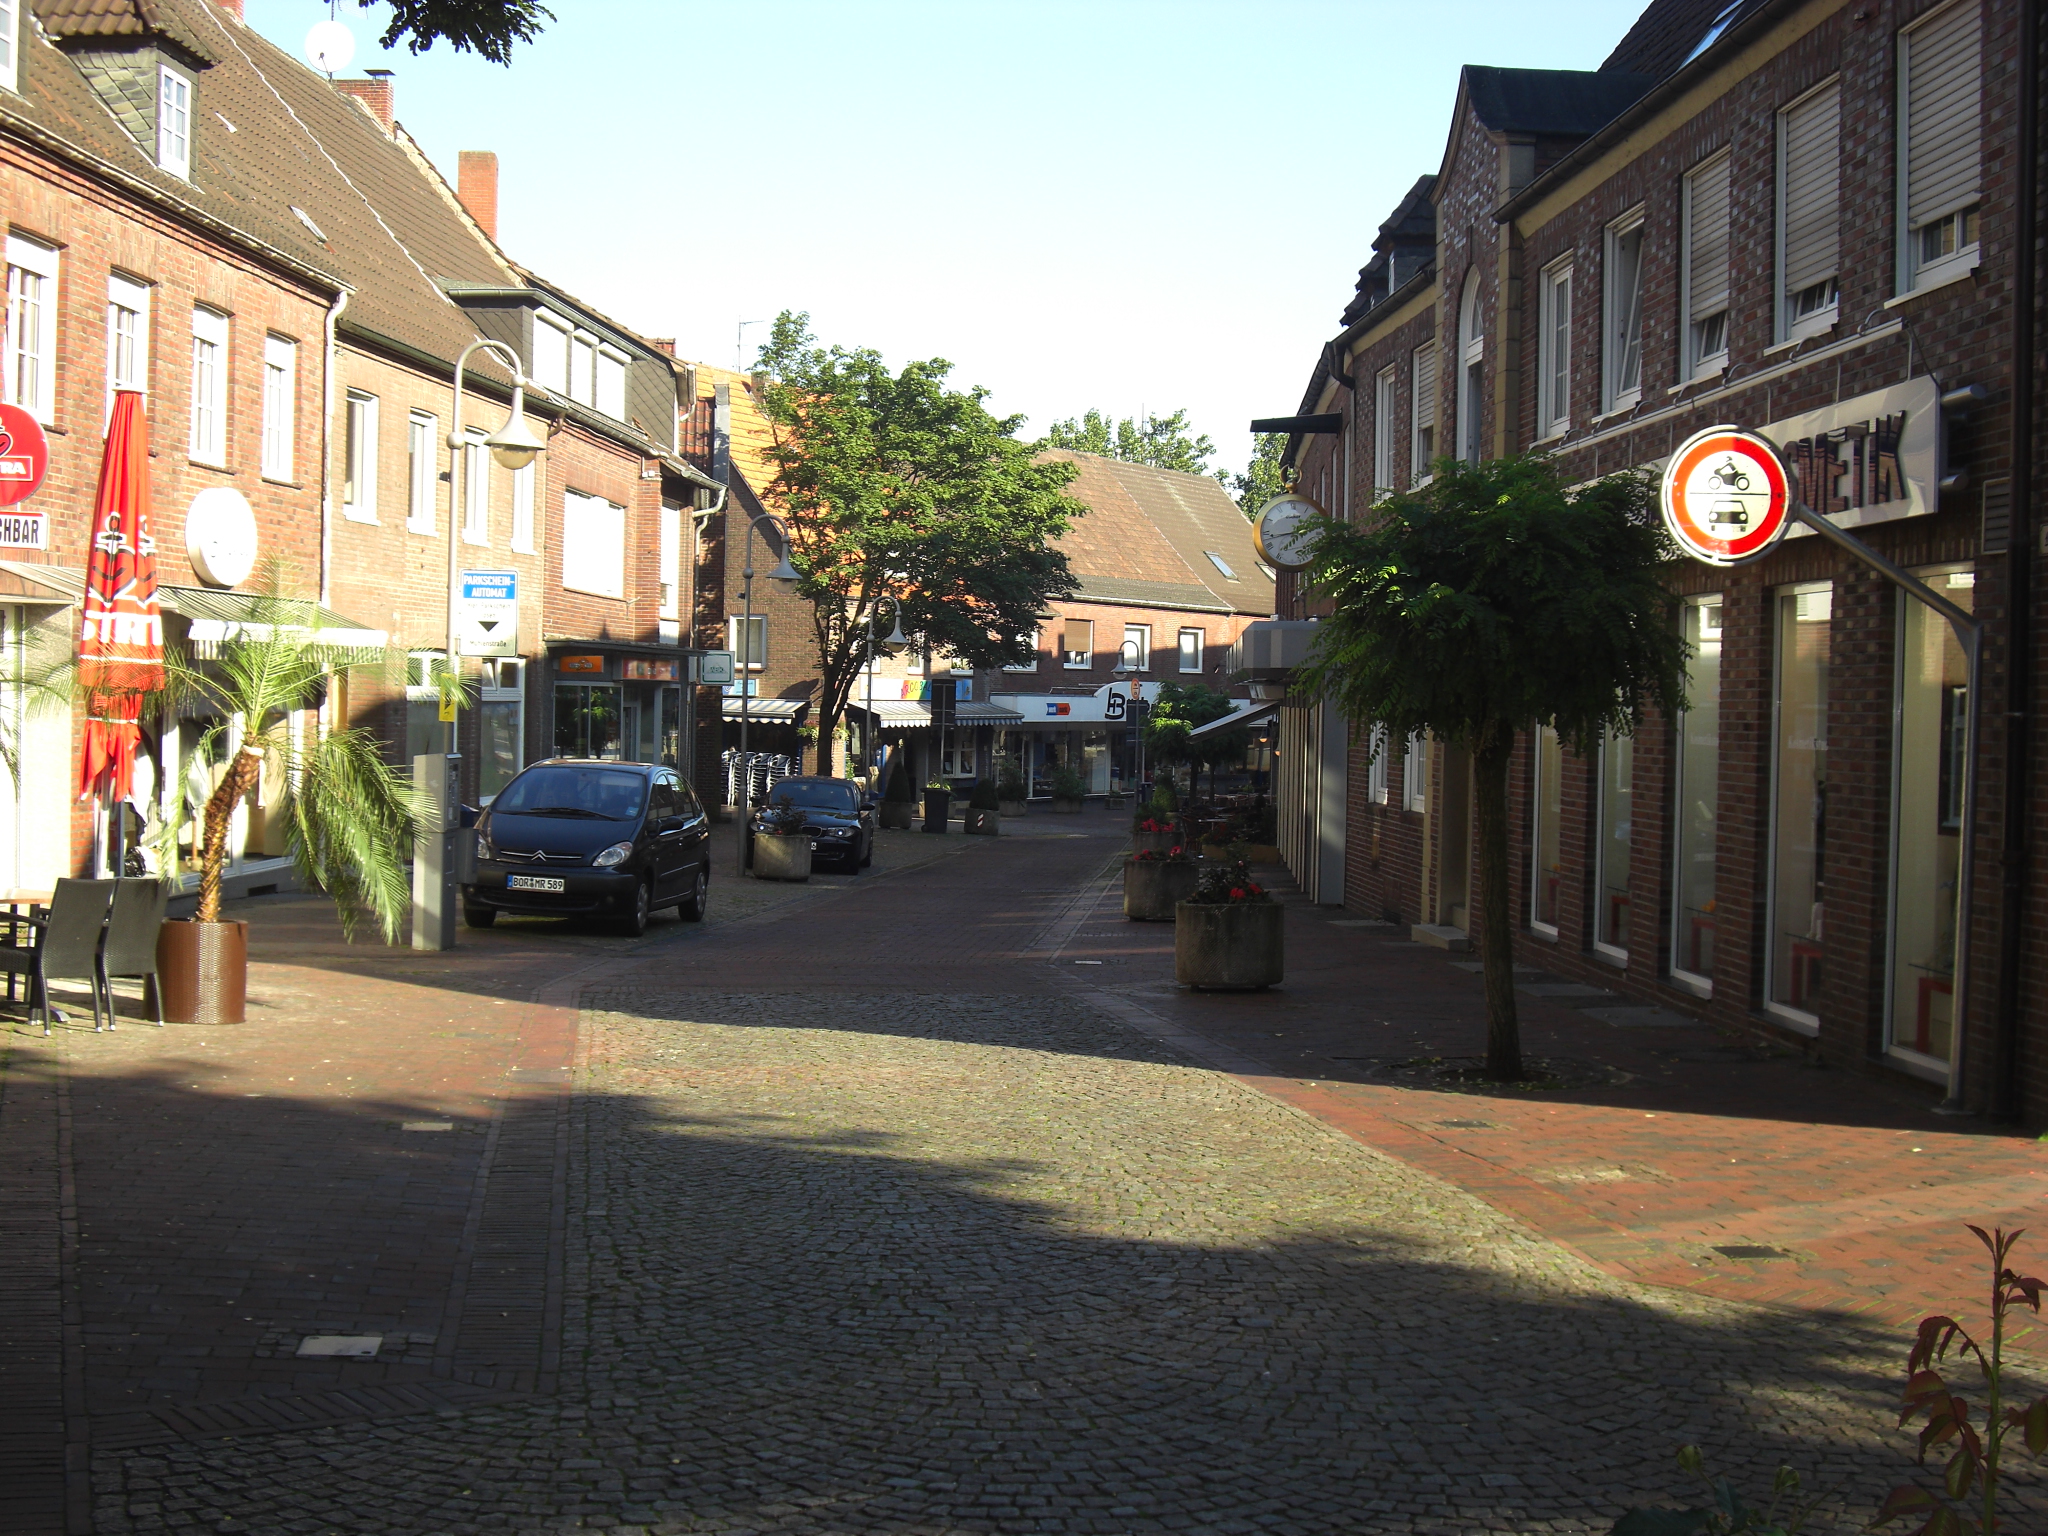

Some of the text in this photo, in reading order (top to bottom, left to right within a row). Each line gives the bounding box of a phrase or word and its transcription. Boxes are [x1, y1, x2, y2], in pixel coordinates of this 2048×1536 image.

[464, 575, 515, 586] PARKSCHEIN-
[471, 587, 508, 598] AUTOMAT
[513, 877, 563, 890] BOR MR 589
